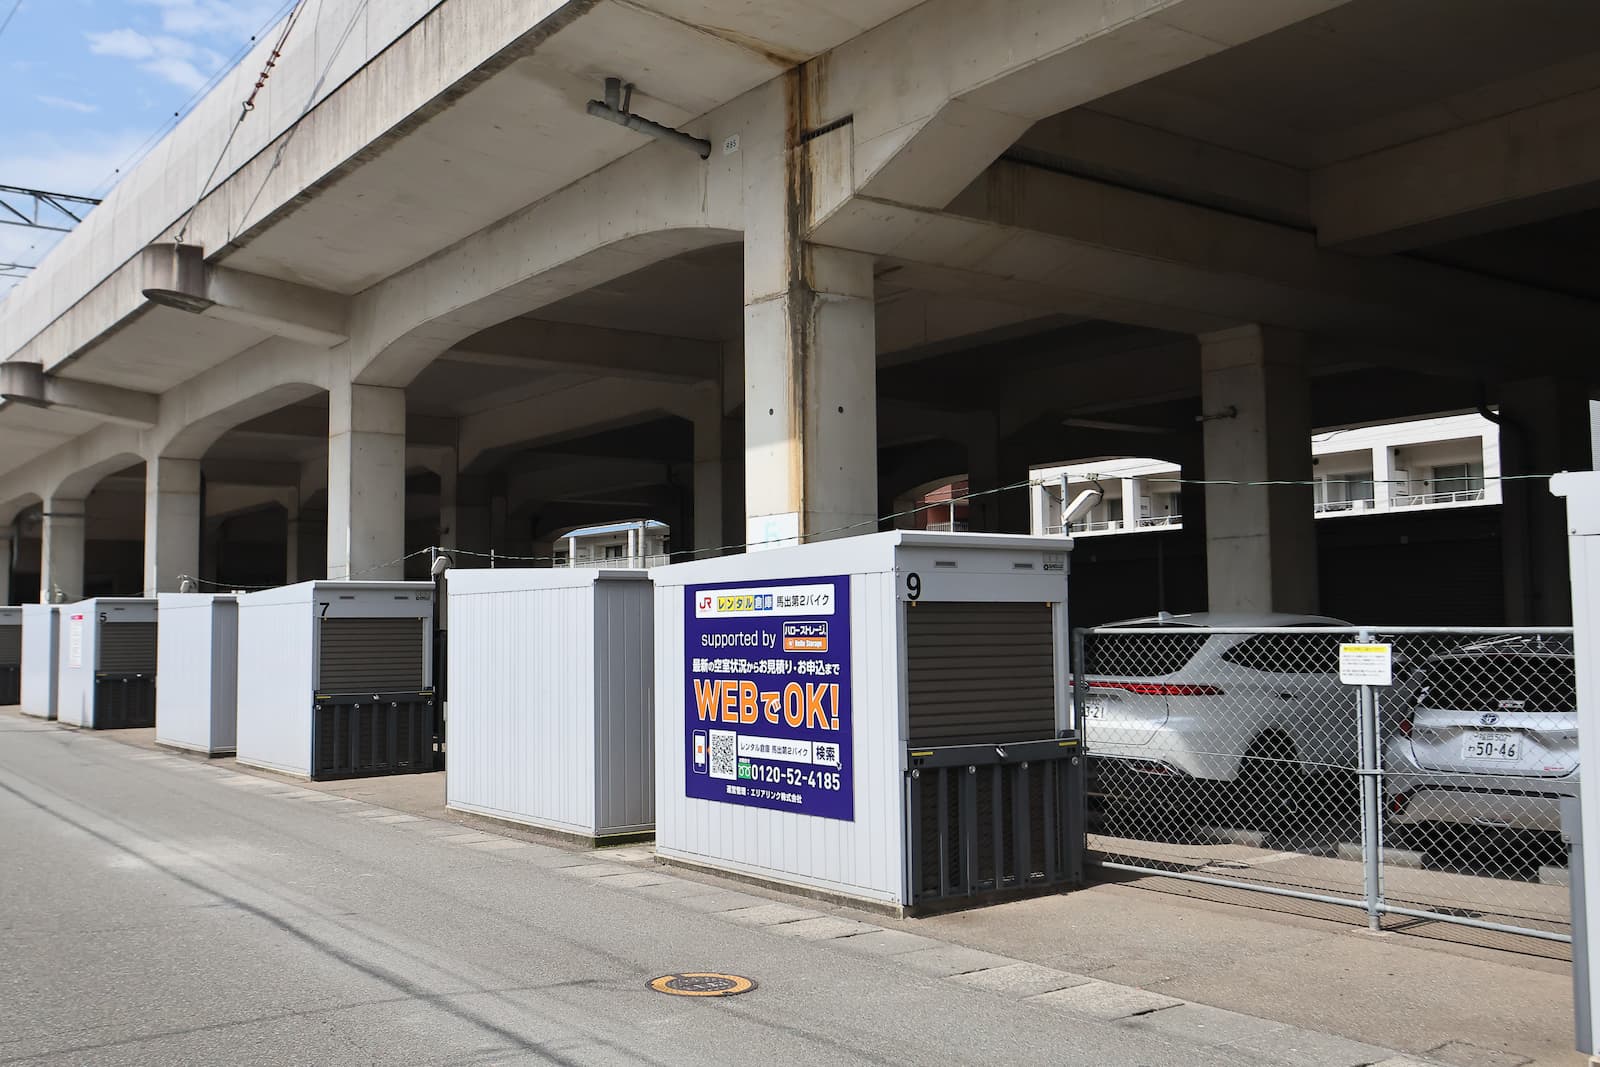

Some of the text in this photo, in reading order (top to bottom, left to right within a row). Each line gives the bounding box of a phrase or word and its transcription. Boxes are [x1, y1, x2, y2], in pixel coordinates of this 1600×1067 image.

[906, 572, 921, 600] 9
[319, 602, 330, 617] 7
[700, 597, 711, 609] JR
[99, 612, 108, 623] 5
[701, 630, 776, 648] supported by
[816, 745, 836, 761] 検索
[1476, 742, 1516, 757] 50-46
[751, 764, 841, 791] 0120-52-4185
